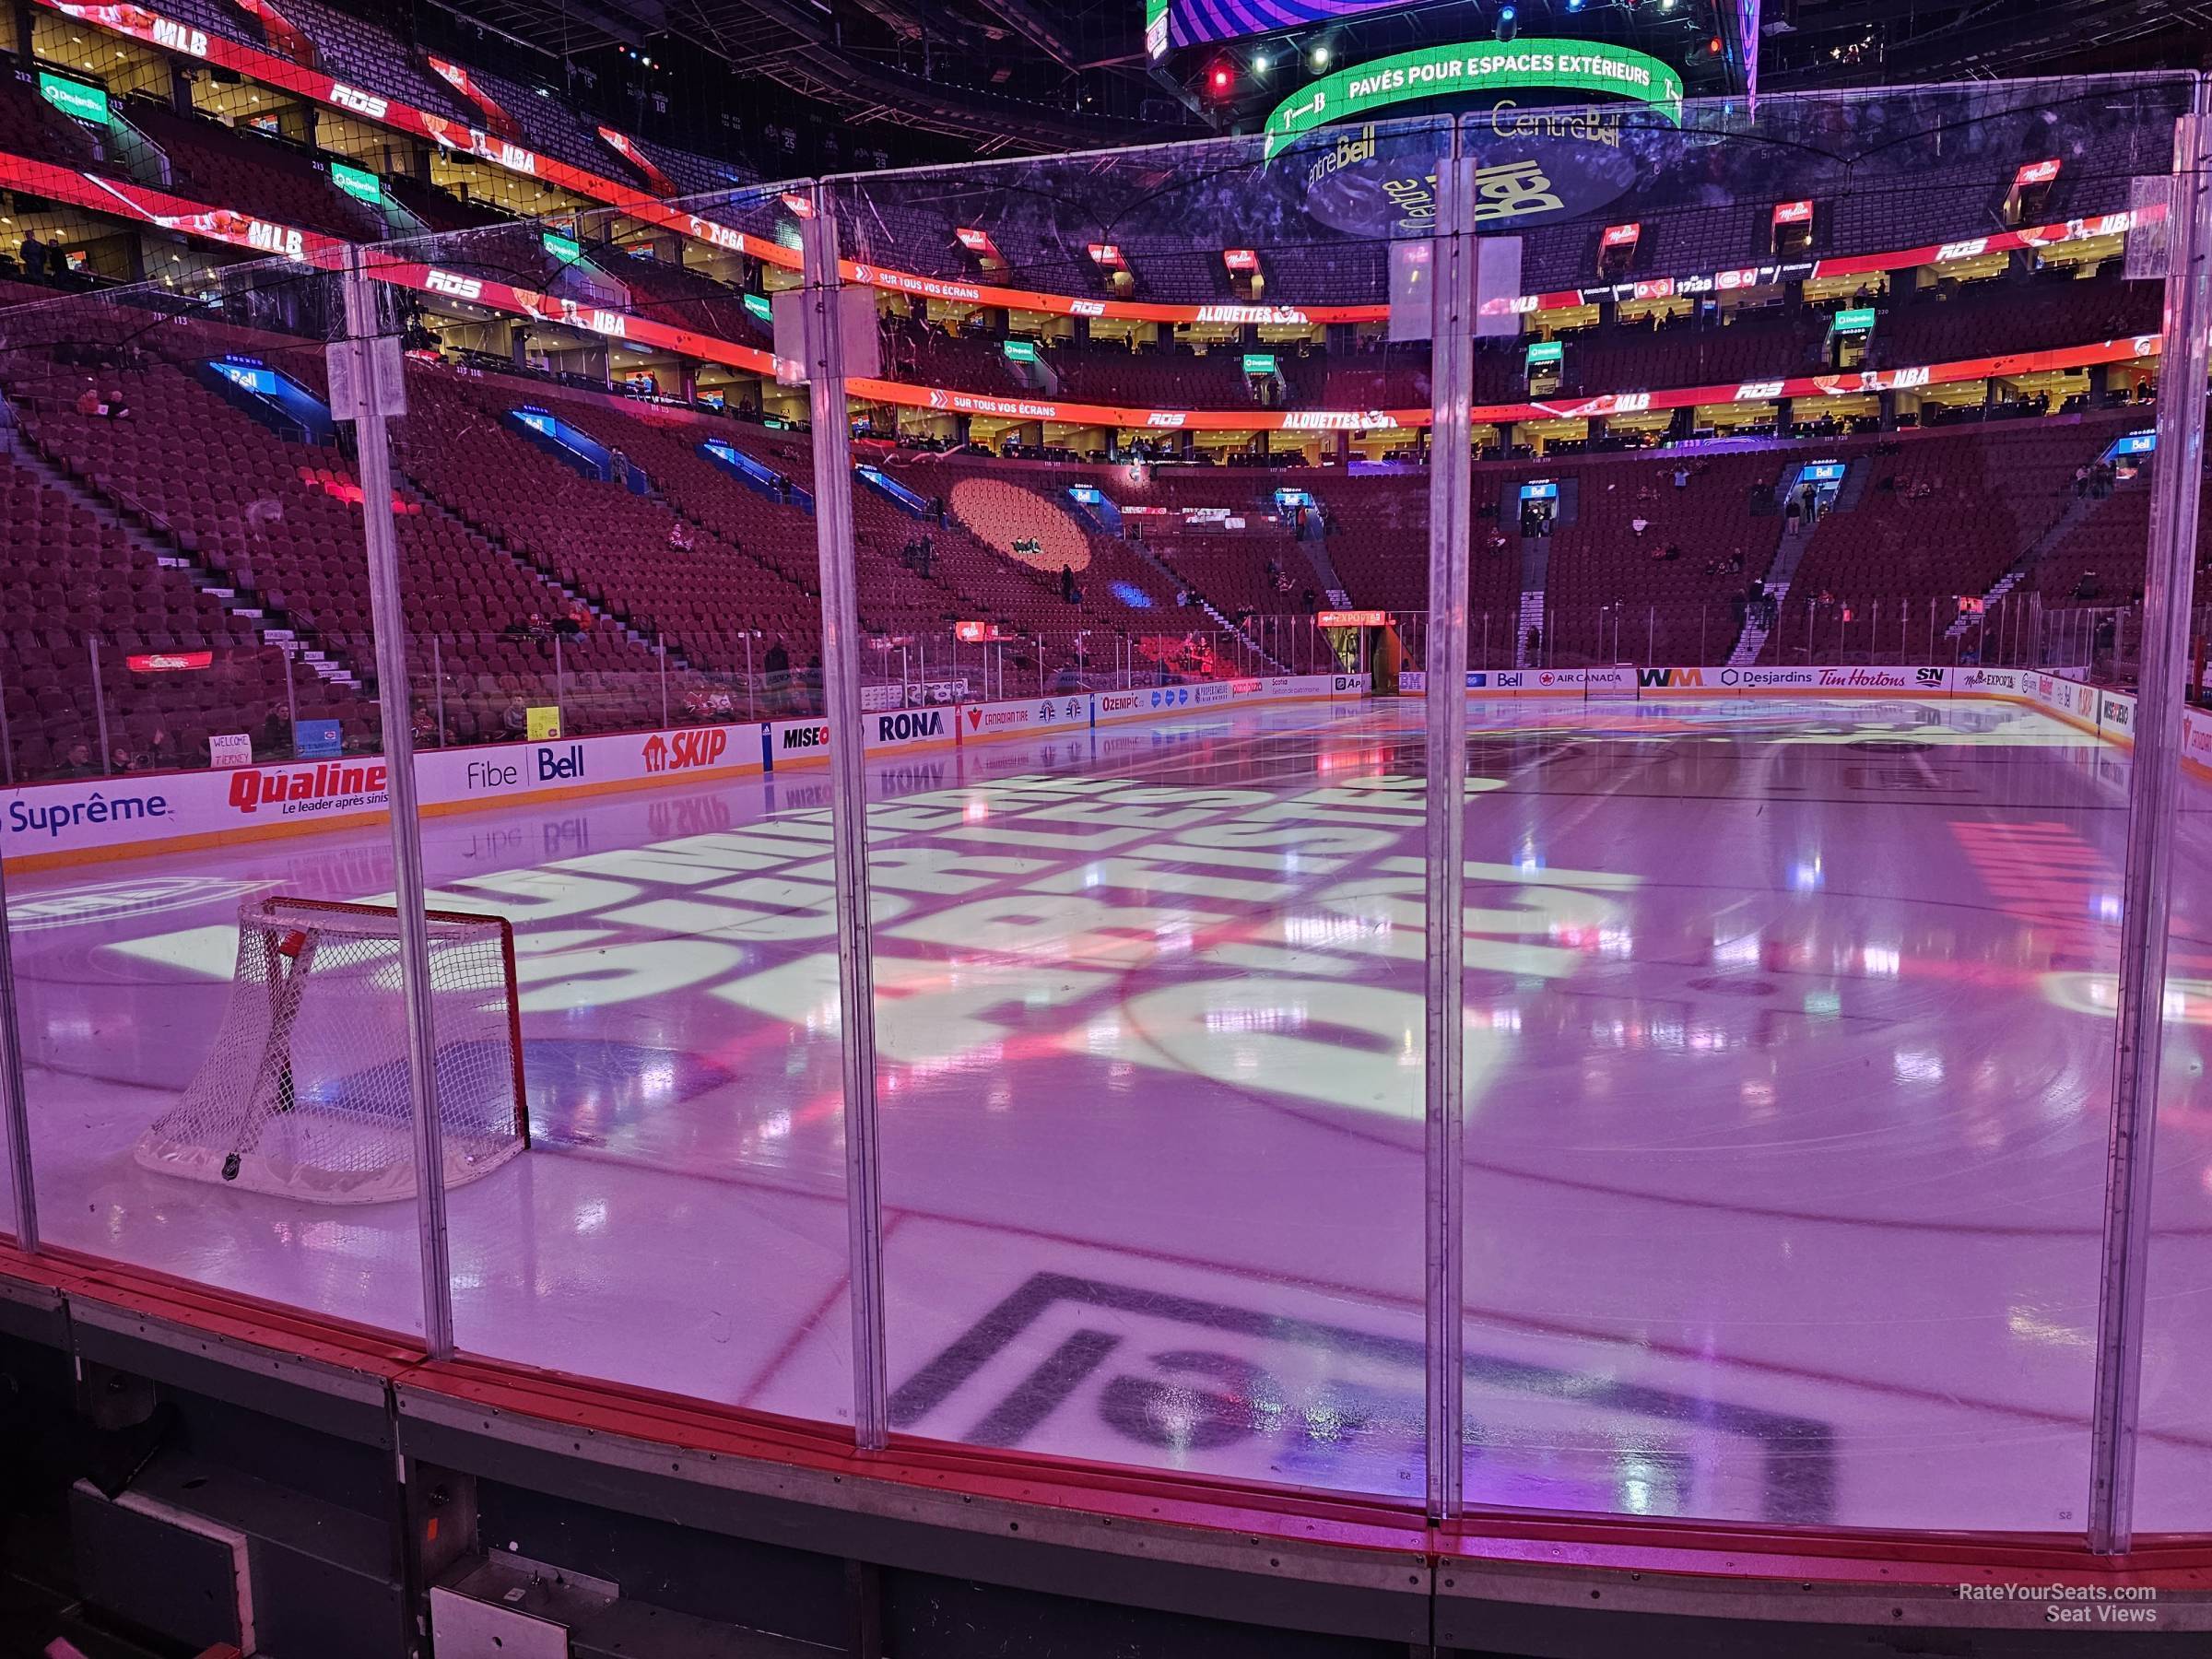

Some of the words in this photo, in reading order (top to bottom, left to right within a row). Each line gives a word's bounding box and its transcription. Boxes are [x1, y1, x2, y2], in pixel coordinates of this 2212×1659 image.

[153, 18, 207, 56] MLB
[15, 71, 32, 83] 212
[1349, 69, 1404, 99] PAVÉS
[1408, 59, 1462, 85] POUR
[1467, 55, 1555, 76] ESPACES
[1559, 55, 1651, 86] EXTÉRIEURS
[60, 90, 102, 112] Desjardins
[501, 144, 535, 173] NBA
[2023, 166, 2057, 182] Molson
[1778, 206, 1808, 220] Molson
[2100, 211, 2137, 232] NBA
[249, 221, 302, 255] MLB
[721, 231, 745, 251] PGA
[880, 272, 897, 285] SUR
[899, 276, 923, 289] TOUS
[924, 281, 941, 294] VOS
[943, 282, 980, 299] ÉCRANS
[593, 311, 626, 335] NBA
[1196, 306, 1272, 323] ALOUETTES
[230, 370, 257, 387] Bell
[1893, 367, 1931, 385] NBA
[953, 396, 971, 410] SUR
[972, 398, 995, 412] TOUS
[998, 400, 1017, 414] VOS
[1018, 400, 1055, 417] ÉCRANS
[1613, 394, 1651, 411] MLB
[1283, 412, 1359, 429] ALOUETTES
[2132, 439, 2150, 451] Bell
[1816, 466, 1832, 478] Bell
[1077, 488, 1090, 500] Bell
[1531, 485, 1546, 495] Bell
[1272, 677, 1288, 686] Scotia
[1497, 673, 1522, 687] Bell
[1557, 674, 1574, 682] AIR
[1576, 673, 1622, 683] CANADA
[1639, 668, 1703, 687] WM
[1744, 671, 1812, 686] Desjardins
[1818, 669, 1845, 686] Tim
[1848, 668, 1905, 687] Hortons
[1915, 668, 1945, 681] SN
[879, 711, 945, 742] RONA
[984, 712, 1015, 726] CANADIAN
[1016, 710, 1029, 724] TIRE
[213, 735, 250, 748] WELCOME
[783, 726, 829, 749] MISEO
[668, 728, 727, 770] SKIP
[215, 752, 250, 766] TIERNEY
[538, 745, 584, 781] Bell
[467, 760, 517, 789] Fibe
[229, 762, 386, 814] Qualine
[282, 802, 297, 816] Le
[298, 797, 333, 815] leader
[335, 794, 365, 812] après
[366, 791, 389, 806] sinis
[9, 793, 167, 837] Suprême
